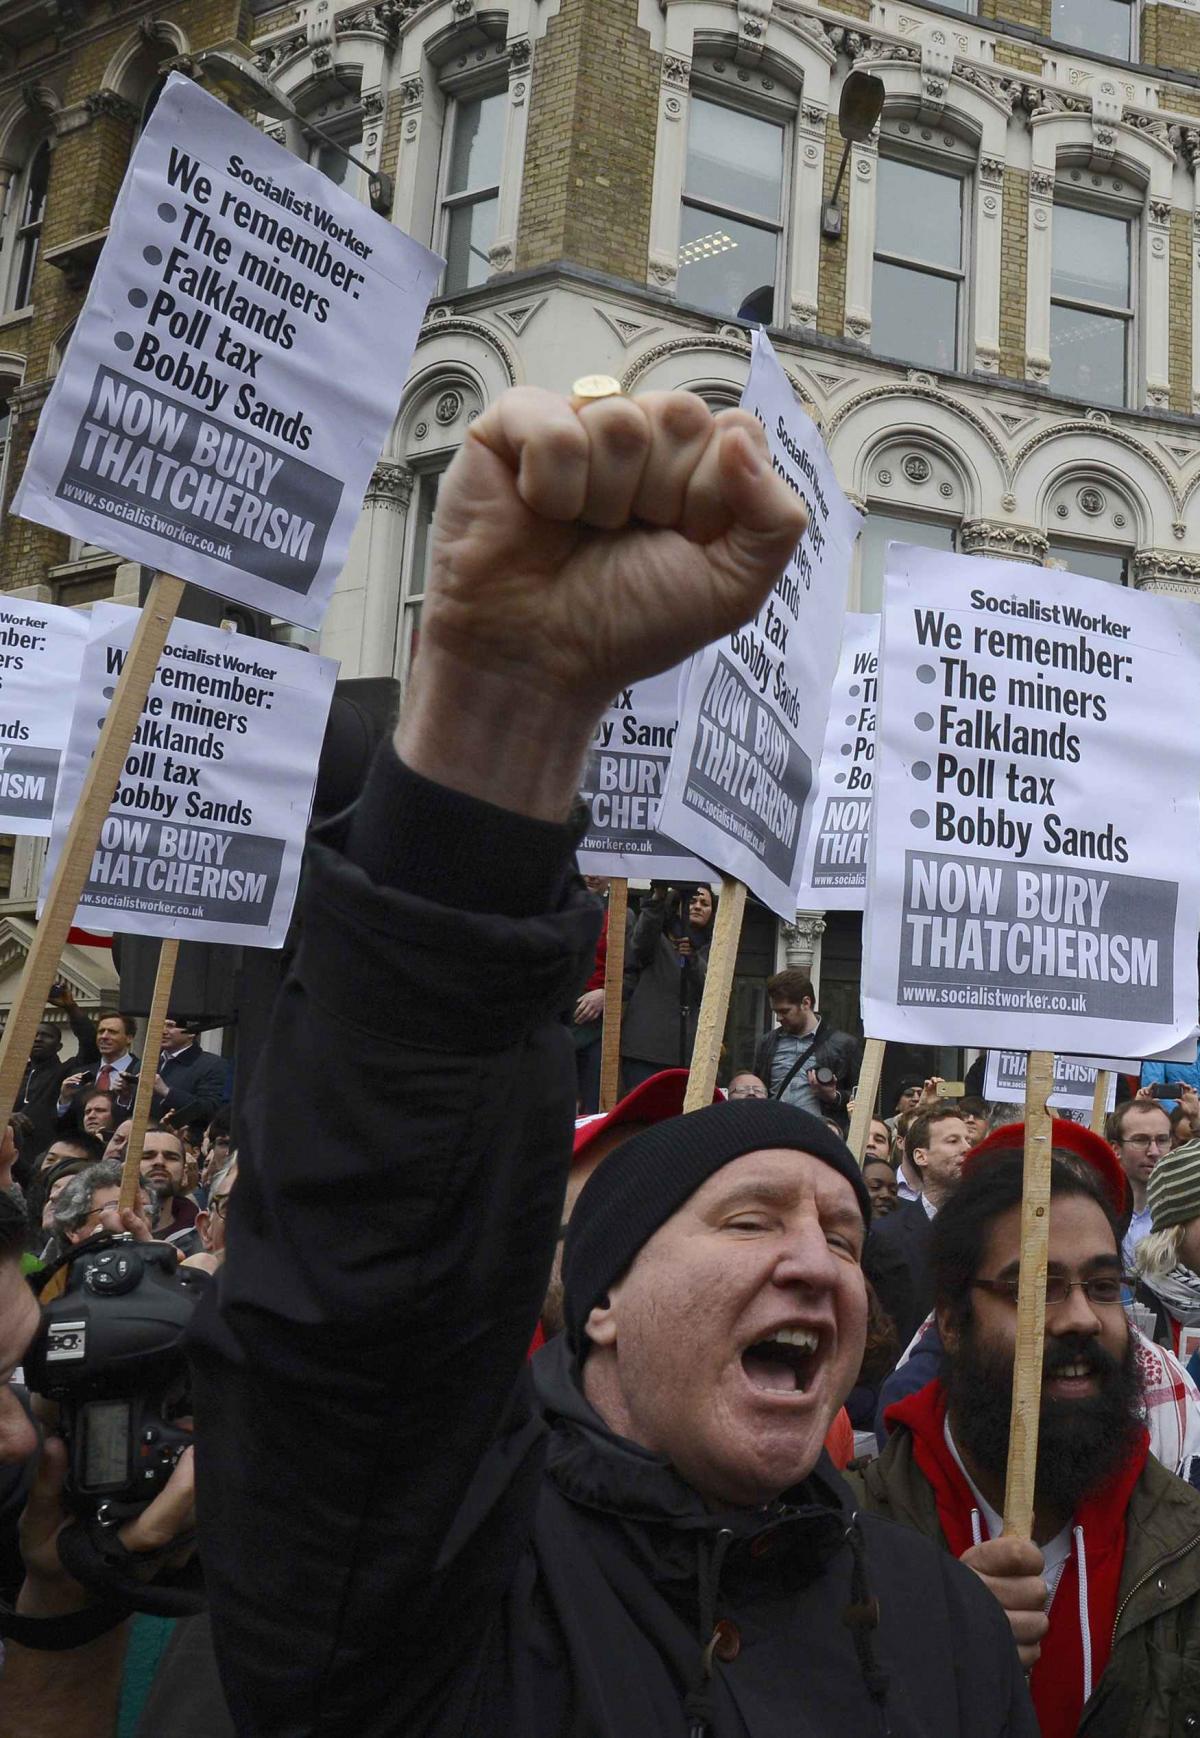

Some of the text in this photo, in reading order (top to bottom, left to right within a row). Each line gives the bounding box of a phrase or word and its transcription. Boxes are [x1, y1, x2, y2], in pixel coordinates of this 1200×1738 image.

[166, 146, 366, 299] We remember:
[180, 204, 331, 324] The miners
[162, 246, 298, 351] Falklands
[147, 289, 263, 379] Poll tax
[133, 337, 313, 452] Bobby Sands
[93, 375, 286, 497] NOW BURY
[62, 481, 233, 563] www.socialistworker.co.uk
[79, 423, 316, 563] THATCHERISM
[106, 646, 127, 676] W
[163, 644, 221, 668] ocialist
[764, 600, 789, 656] tax
[913, 609, 1134, 683] We remember:
[170, 698, 248, 734] miners
[703, 661, 790, 783] NOW BURY
[773, 661, 800, 729] Sands
[939, 657, 1107, 722] The miners
[131, 719, 225, 760] alklands
[939, 704, 1081, 763] Falklands
[124, 751, 200, 787] oll tax
[695, 713, 799, 849] THATCHERISM
[936, 754, 1055, 806] Poll tax
[100, 816, 233, 866] OW BURY
[184, 791, 253, 826] Sands
[934, 802, 1129, 863] Bobby Sands
[89, 850, 268, 904] HATCHERISM
[910, 859, 1109, 928] NOW BURY
[906, 914, 1158, 988] THATCHERISM
[902, 985, 1088, 1012] www.socialistworker.co.uk
